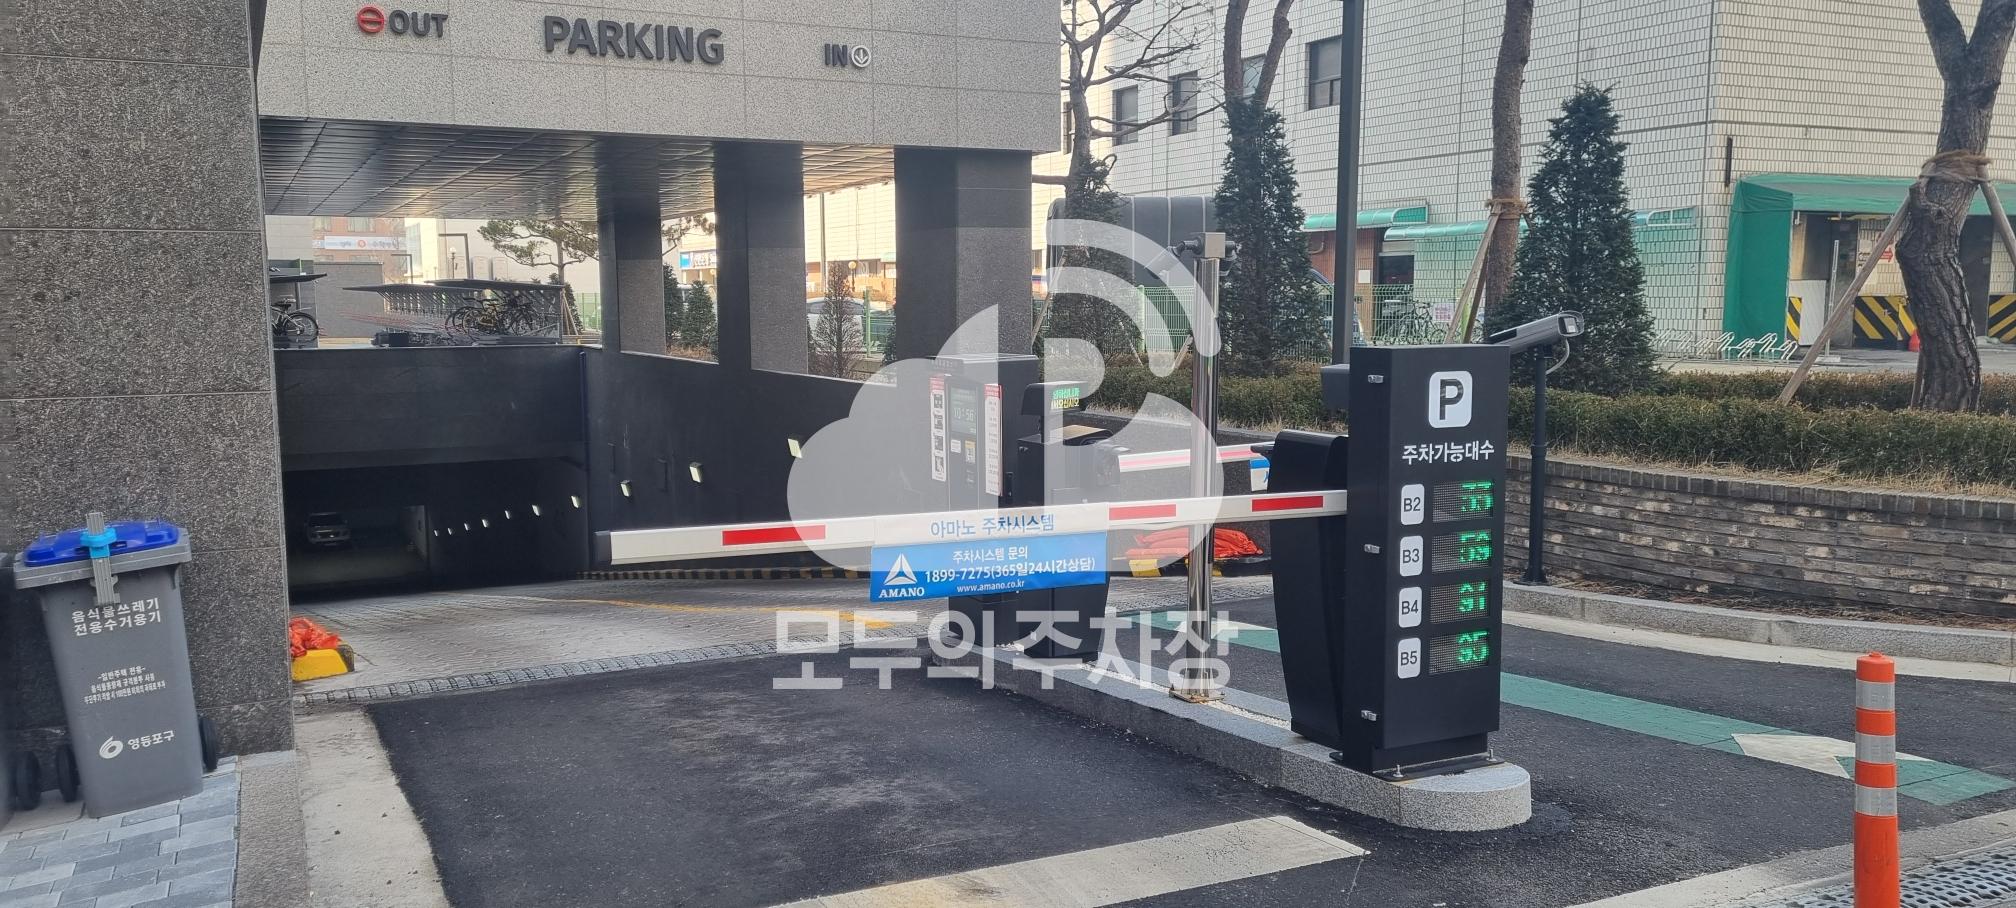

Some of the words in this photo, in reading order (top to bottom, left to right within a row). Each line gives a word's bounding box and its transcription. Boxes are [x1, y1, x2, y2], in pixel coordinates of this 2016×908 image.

[389, 10, 448, 37] OUT
[544, 16, 725, 64] PARKING
[824, 43, 849, 67] IN
[1439, 379, 1464, 421] P
[1402, 440, 1495, 465] 주차가능대수
[1403, 496, 1421, 512] B2
[930, 518, 977, 538] 아마노
[982, 514, 1054, 535] 주차시스템
[952, 549, 1005, 564] 주차시스템
[1007, 545, 1028, 560] 문의
[1402, 548, 1420, 564] B3
[925, 557, 1096, 583] 1899-7275(365일24시간상담)
[878, 586, 925, 599] AMANO
[956, 579, 1025, 593] www.amano.co.kr
[72, 598, 160, 622] 음식물쓰레기
[1401, 599, 1419, 615] B4
[74, 611, 162, 636] 전용수거용기
[1400, 650, 1418, 666] B5
[127, 730, 175, 750] 영등포구
